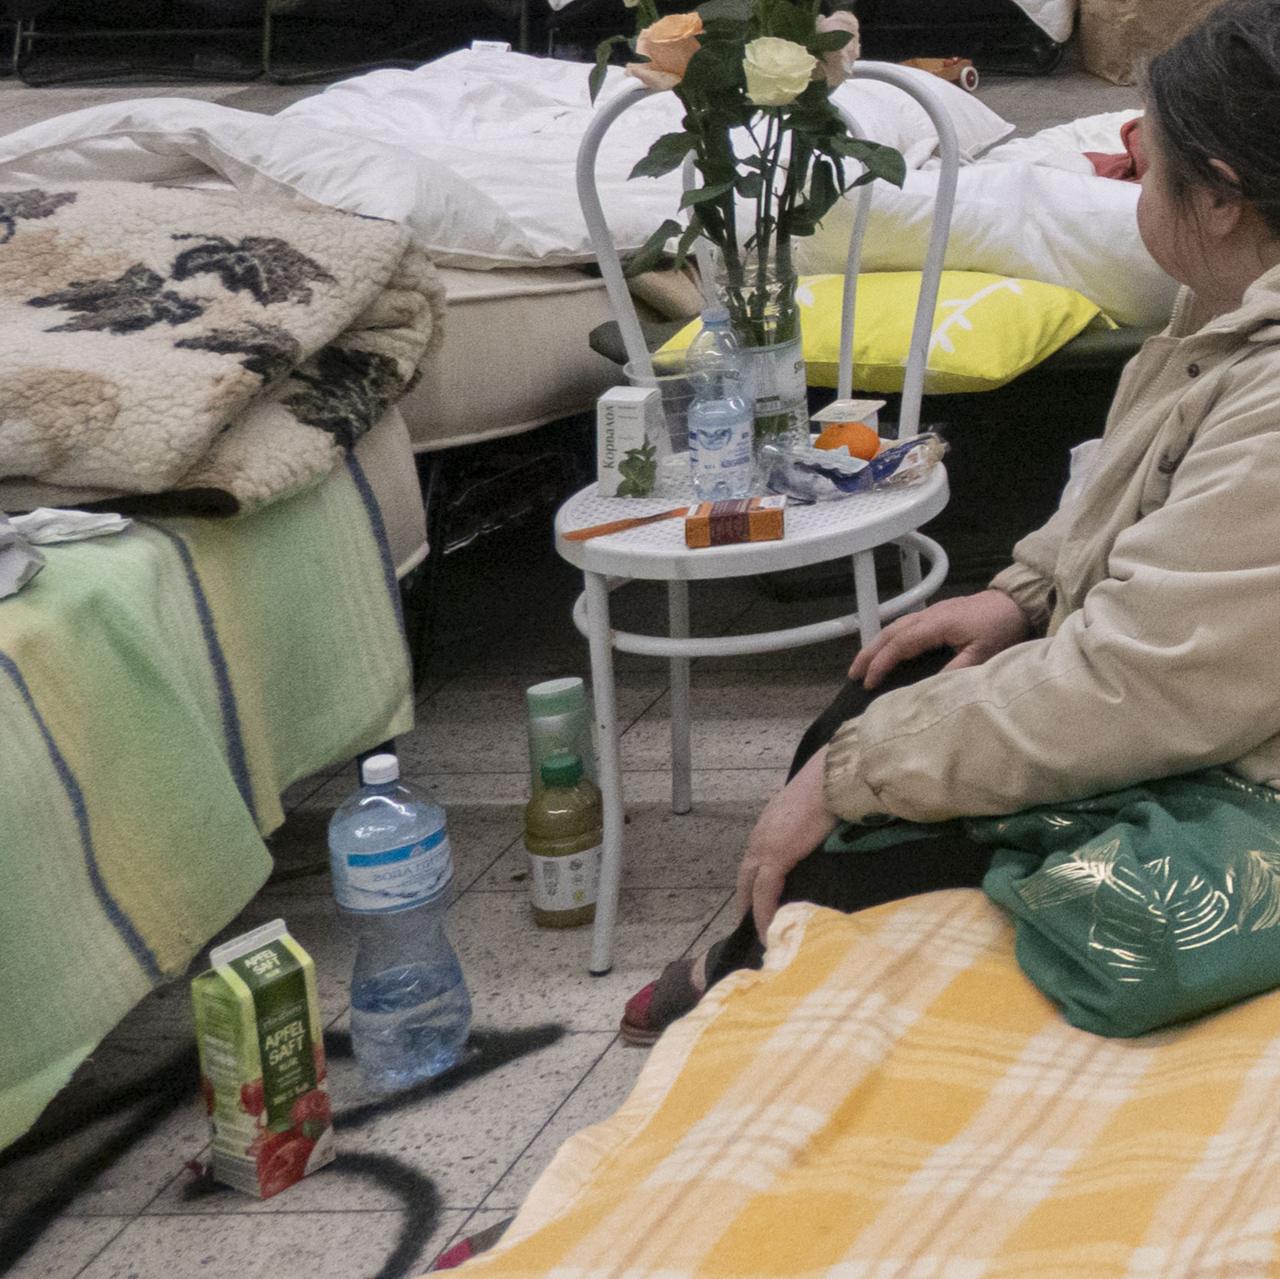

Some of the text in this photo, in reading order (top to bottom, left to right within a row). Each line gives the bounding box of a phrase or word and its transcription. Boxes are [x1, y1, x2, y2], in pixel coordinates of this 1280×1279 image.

[602, 406, 617, 469] Корвалол
[244, 949, 278, 969] APFEL
[253, 956, 281, 975] SAFT
[265, 1021, 306, 1051] APFEL
[269, 1035, 303, 1067] SAFT
